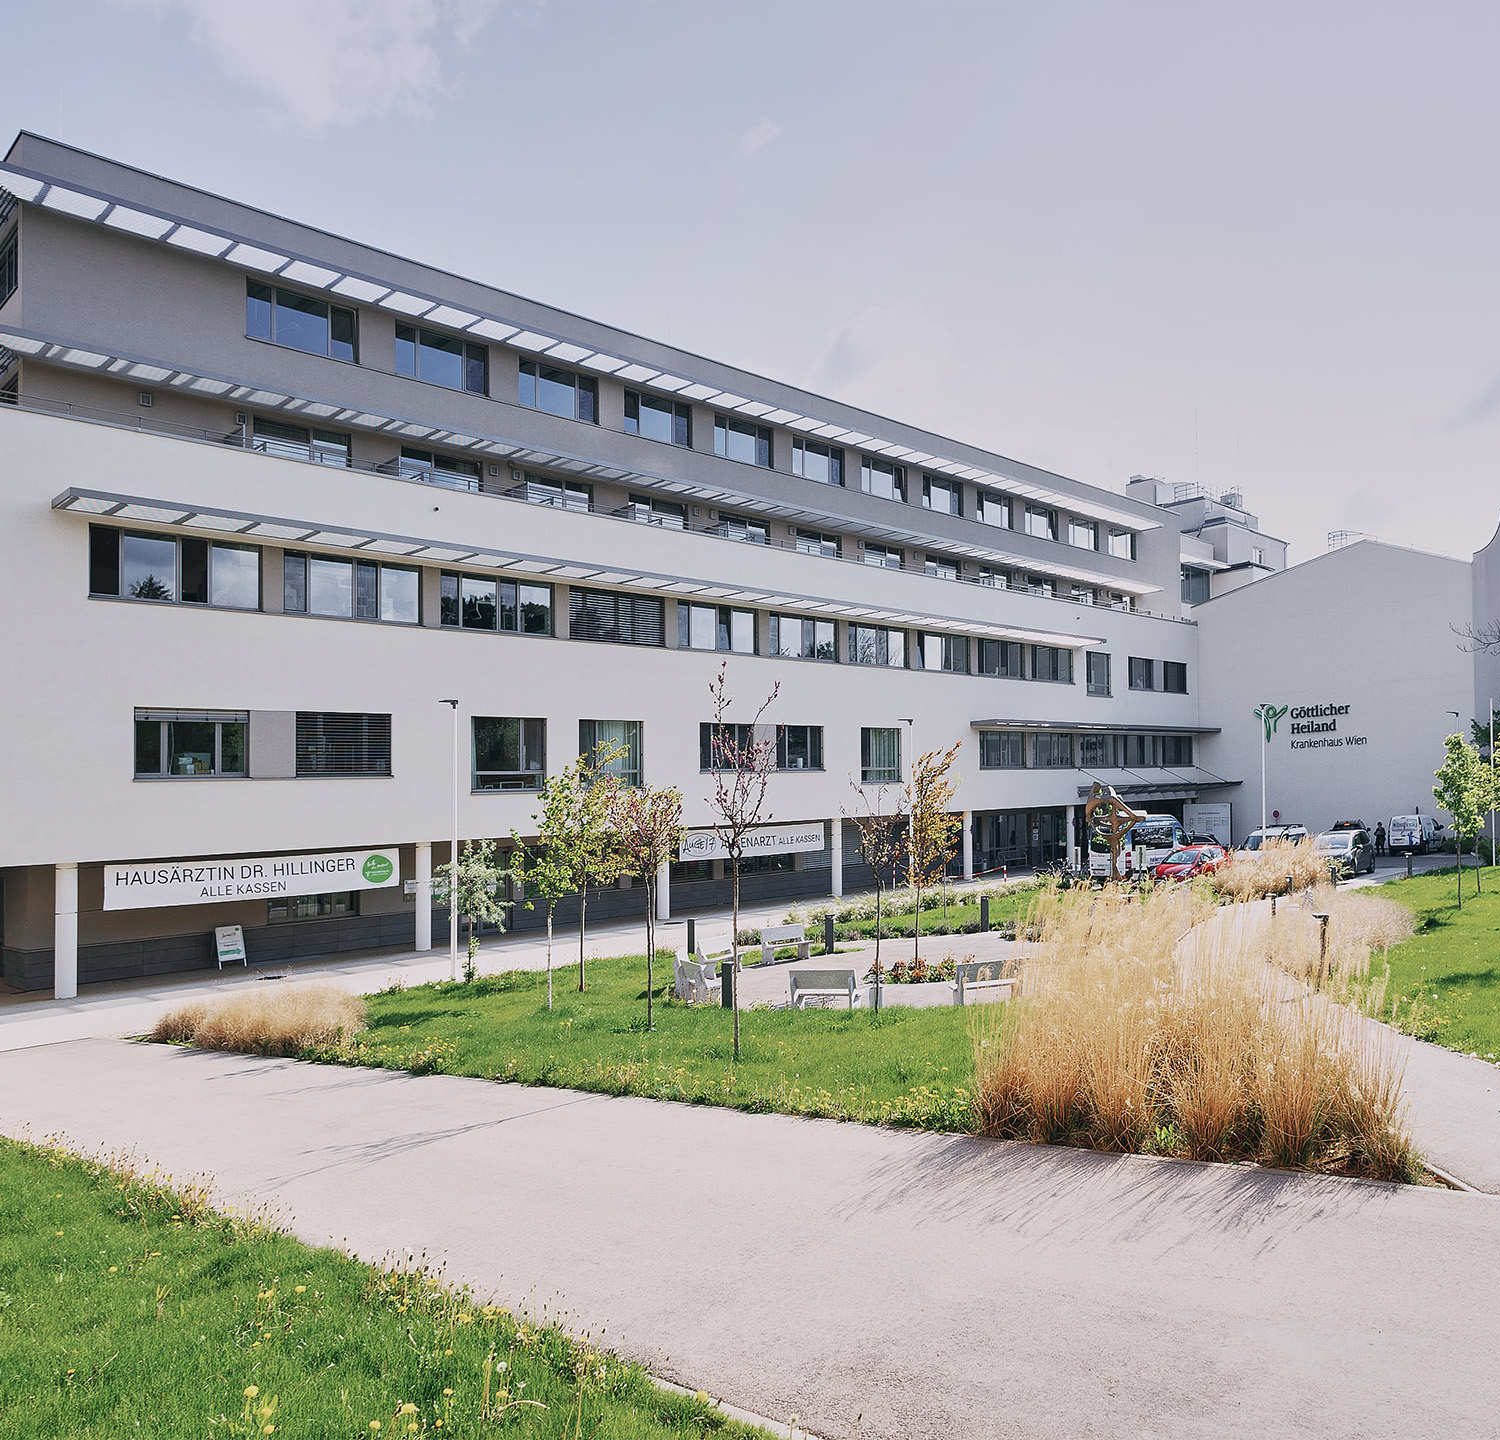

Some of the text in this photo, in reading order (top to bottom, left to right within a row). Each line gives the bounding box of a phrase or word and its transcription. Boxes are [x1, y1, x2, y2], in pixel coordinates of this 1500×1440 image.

[1290, 703, 1351, 719] Göttlicher
[1290, 719, 1337, 734] Heiland
[1291, 735, 1368, 750] Krankenhaus Wien
[721, 835, 777, 849] AENARZT
[779, 836, 794, 845] ALLE
[795, 834, 821, 843] KASSEN
[116, 866, 235, 886] HAUSÄRZTIN
[240, 864, 268, 879] DR.
[273, 858, 356, 877] HILLINGER
[200, 881, 287, 897] ALLE KASSEN
